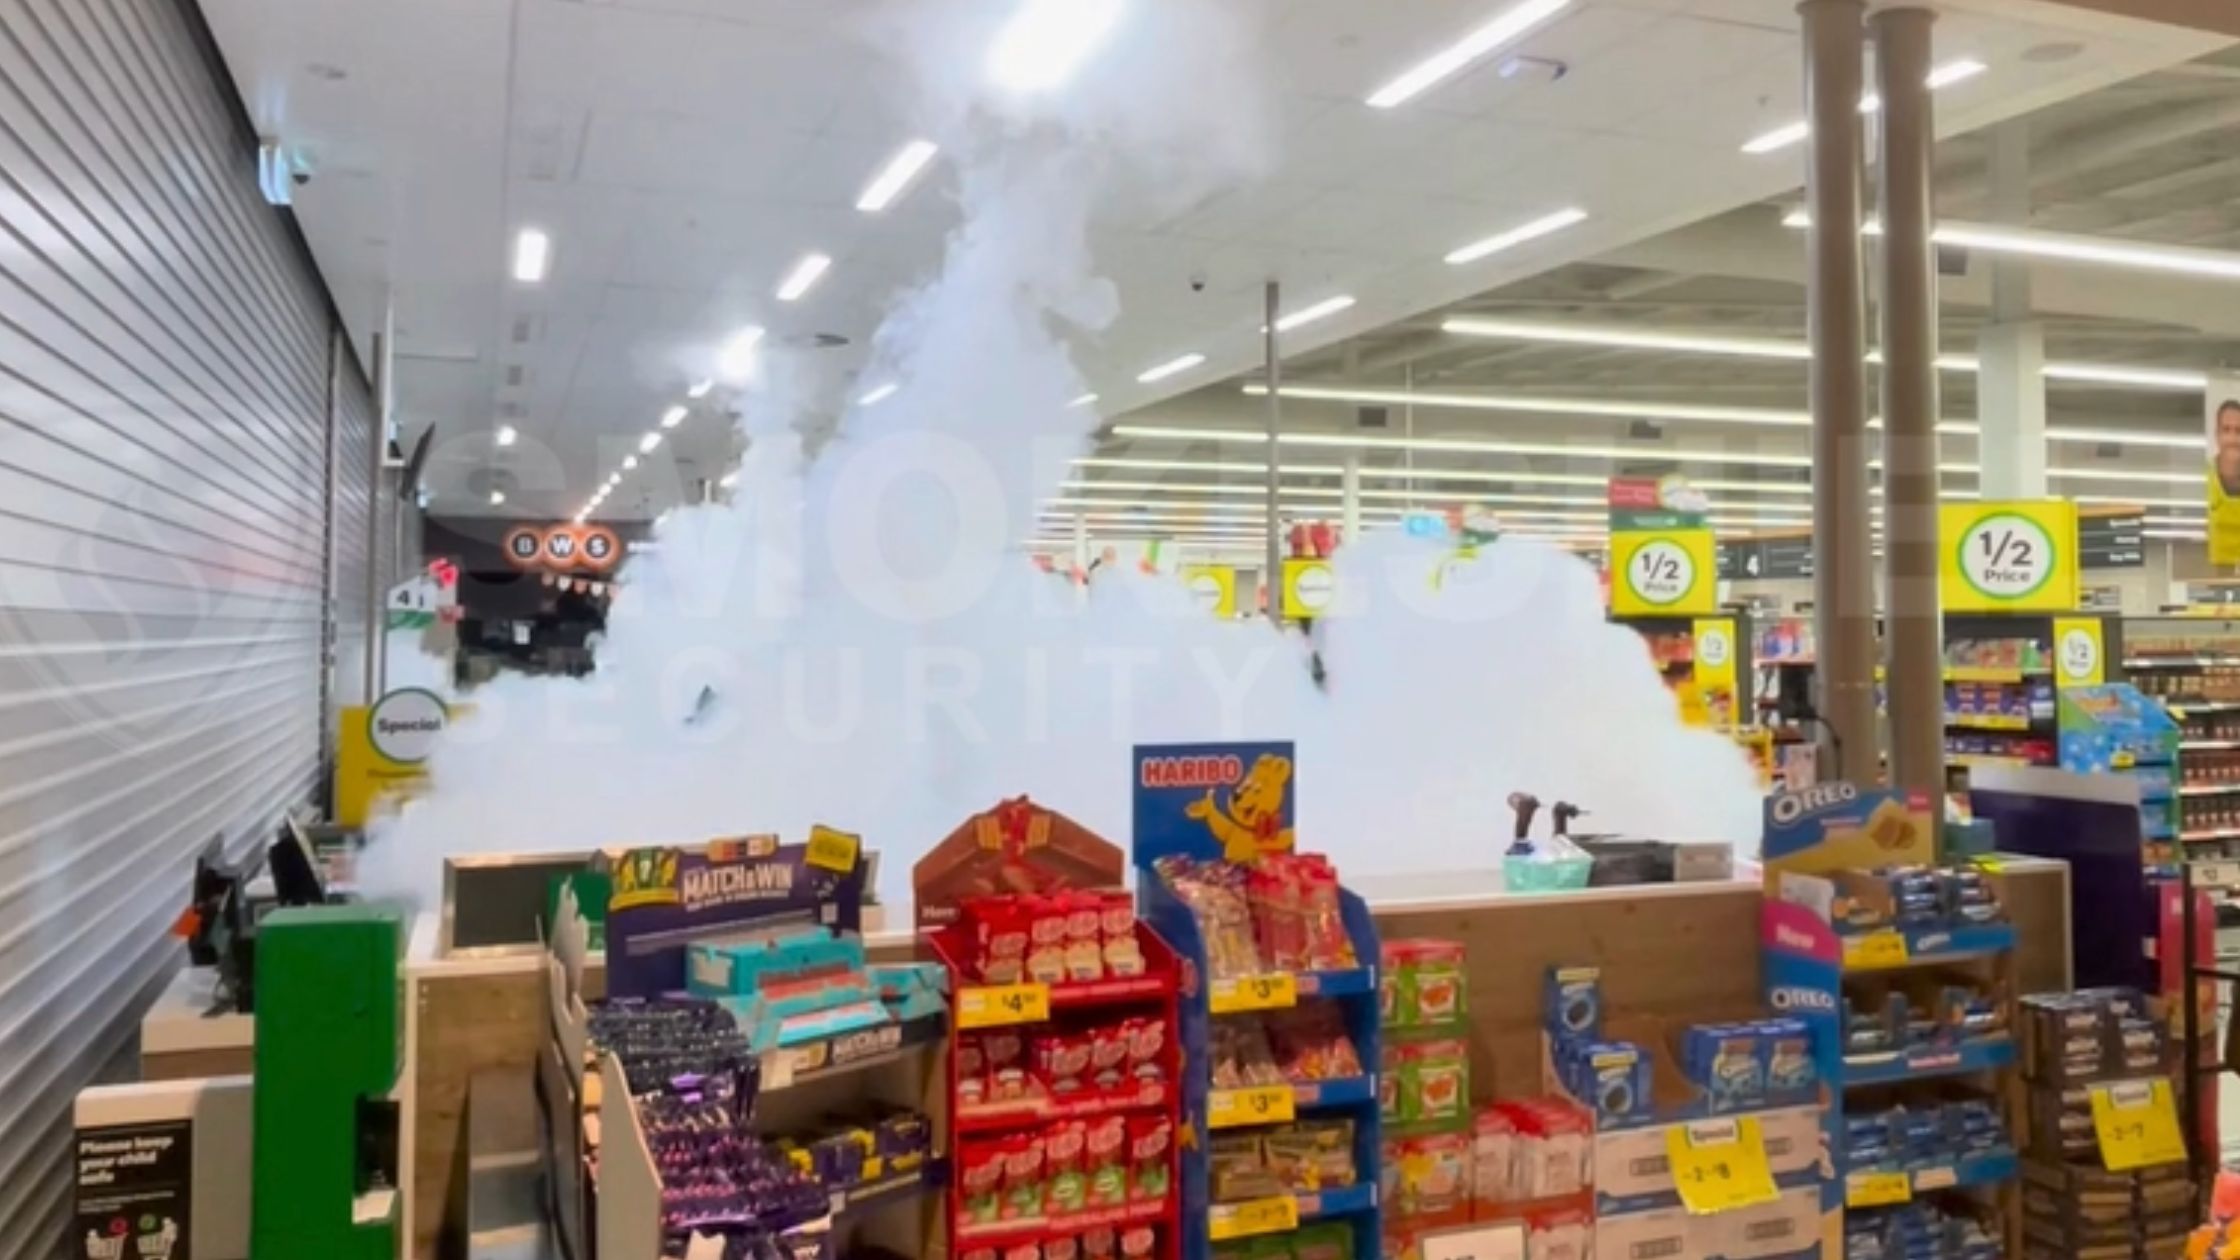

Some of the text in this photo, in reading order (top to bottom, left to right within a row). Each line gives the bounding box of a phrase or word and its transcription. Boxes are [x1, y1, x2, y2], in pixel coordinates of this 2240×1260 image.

[517, 535, 605, 554] BWS
[1979, 531, 2034, 567] 1/2
[1641, 552, 1680, 580] 1/2
[1747, 556, 1759, 575] 4
[1984, 567, 2031, 583] Price
[396, 590, 410, 606] 4
[378, 717, 442, 735] Special
[1142, 755, 1241, 788] HARIBO
[1773, 783, 1857, 822] OREO
[1771, 988, 1835, 1009] OREO
[79, 1137, 175, 1154] Please keep
[79, 1151, 157, 1172] your child
